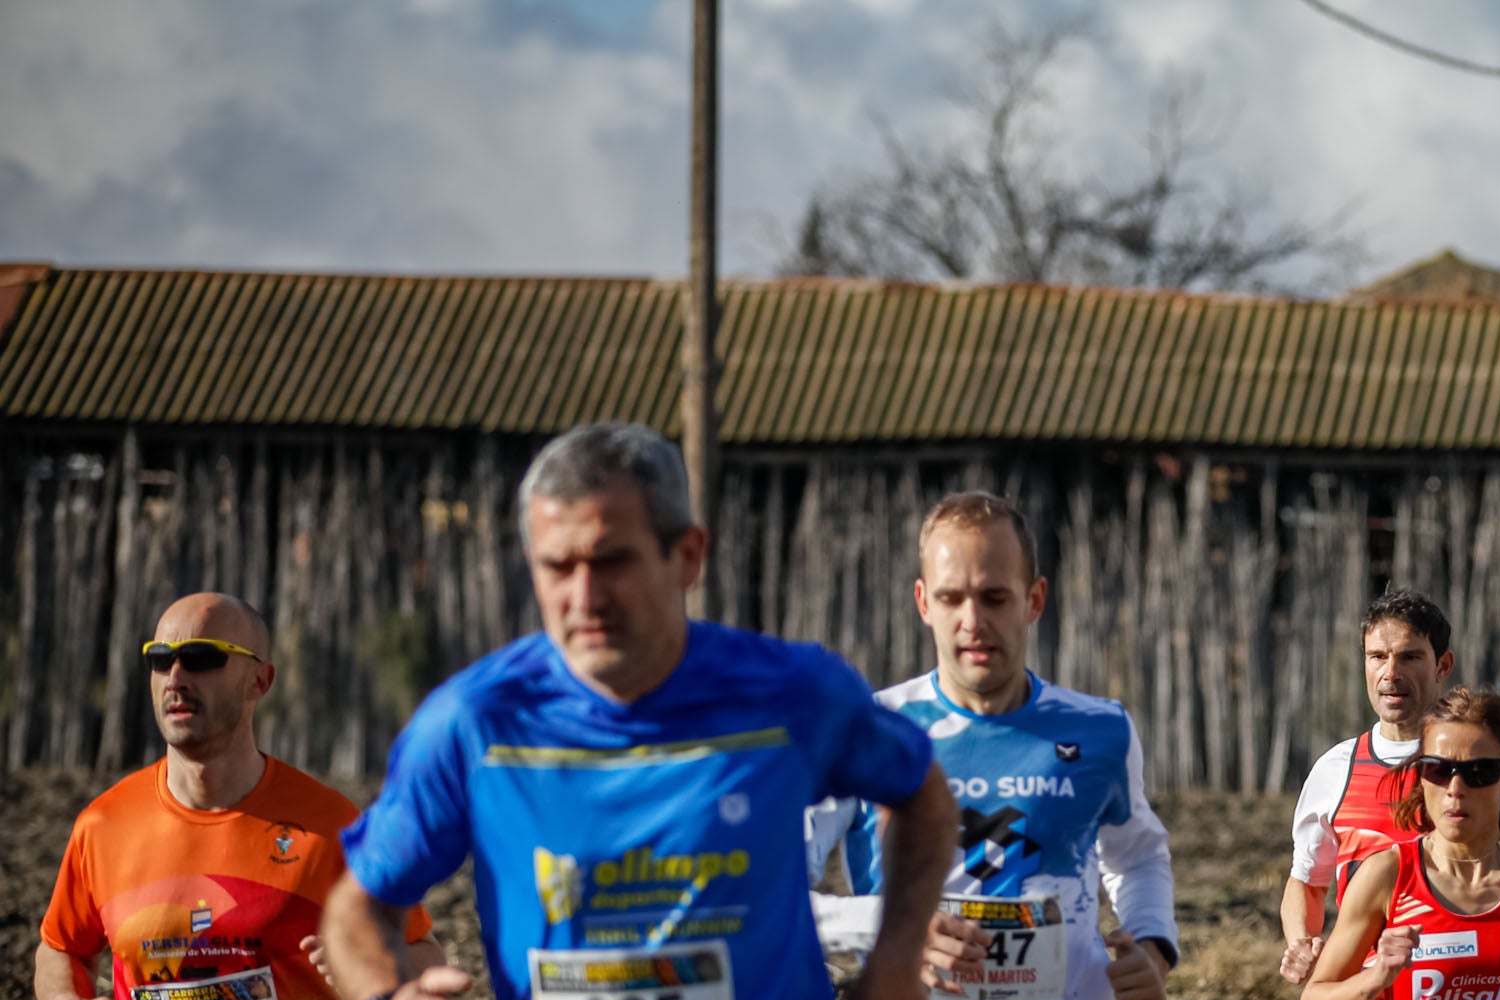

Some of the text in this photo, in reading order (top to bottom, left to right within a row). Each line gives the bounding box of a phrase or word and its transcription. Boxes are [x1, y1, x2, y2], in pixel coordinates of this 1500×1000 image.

[947, 776, 1076, 798] DO SUMA
[593, 847, 750, 885] olimpo
[188, 948, 199, 957] de
[200, 947, 229, 956] Vidrio
[986, 931, 1036, 967] 47
[988, 968, 1037, 985] MARTOS
[168, 985, 218, 999] CARRERA
